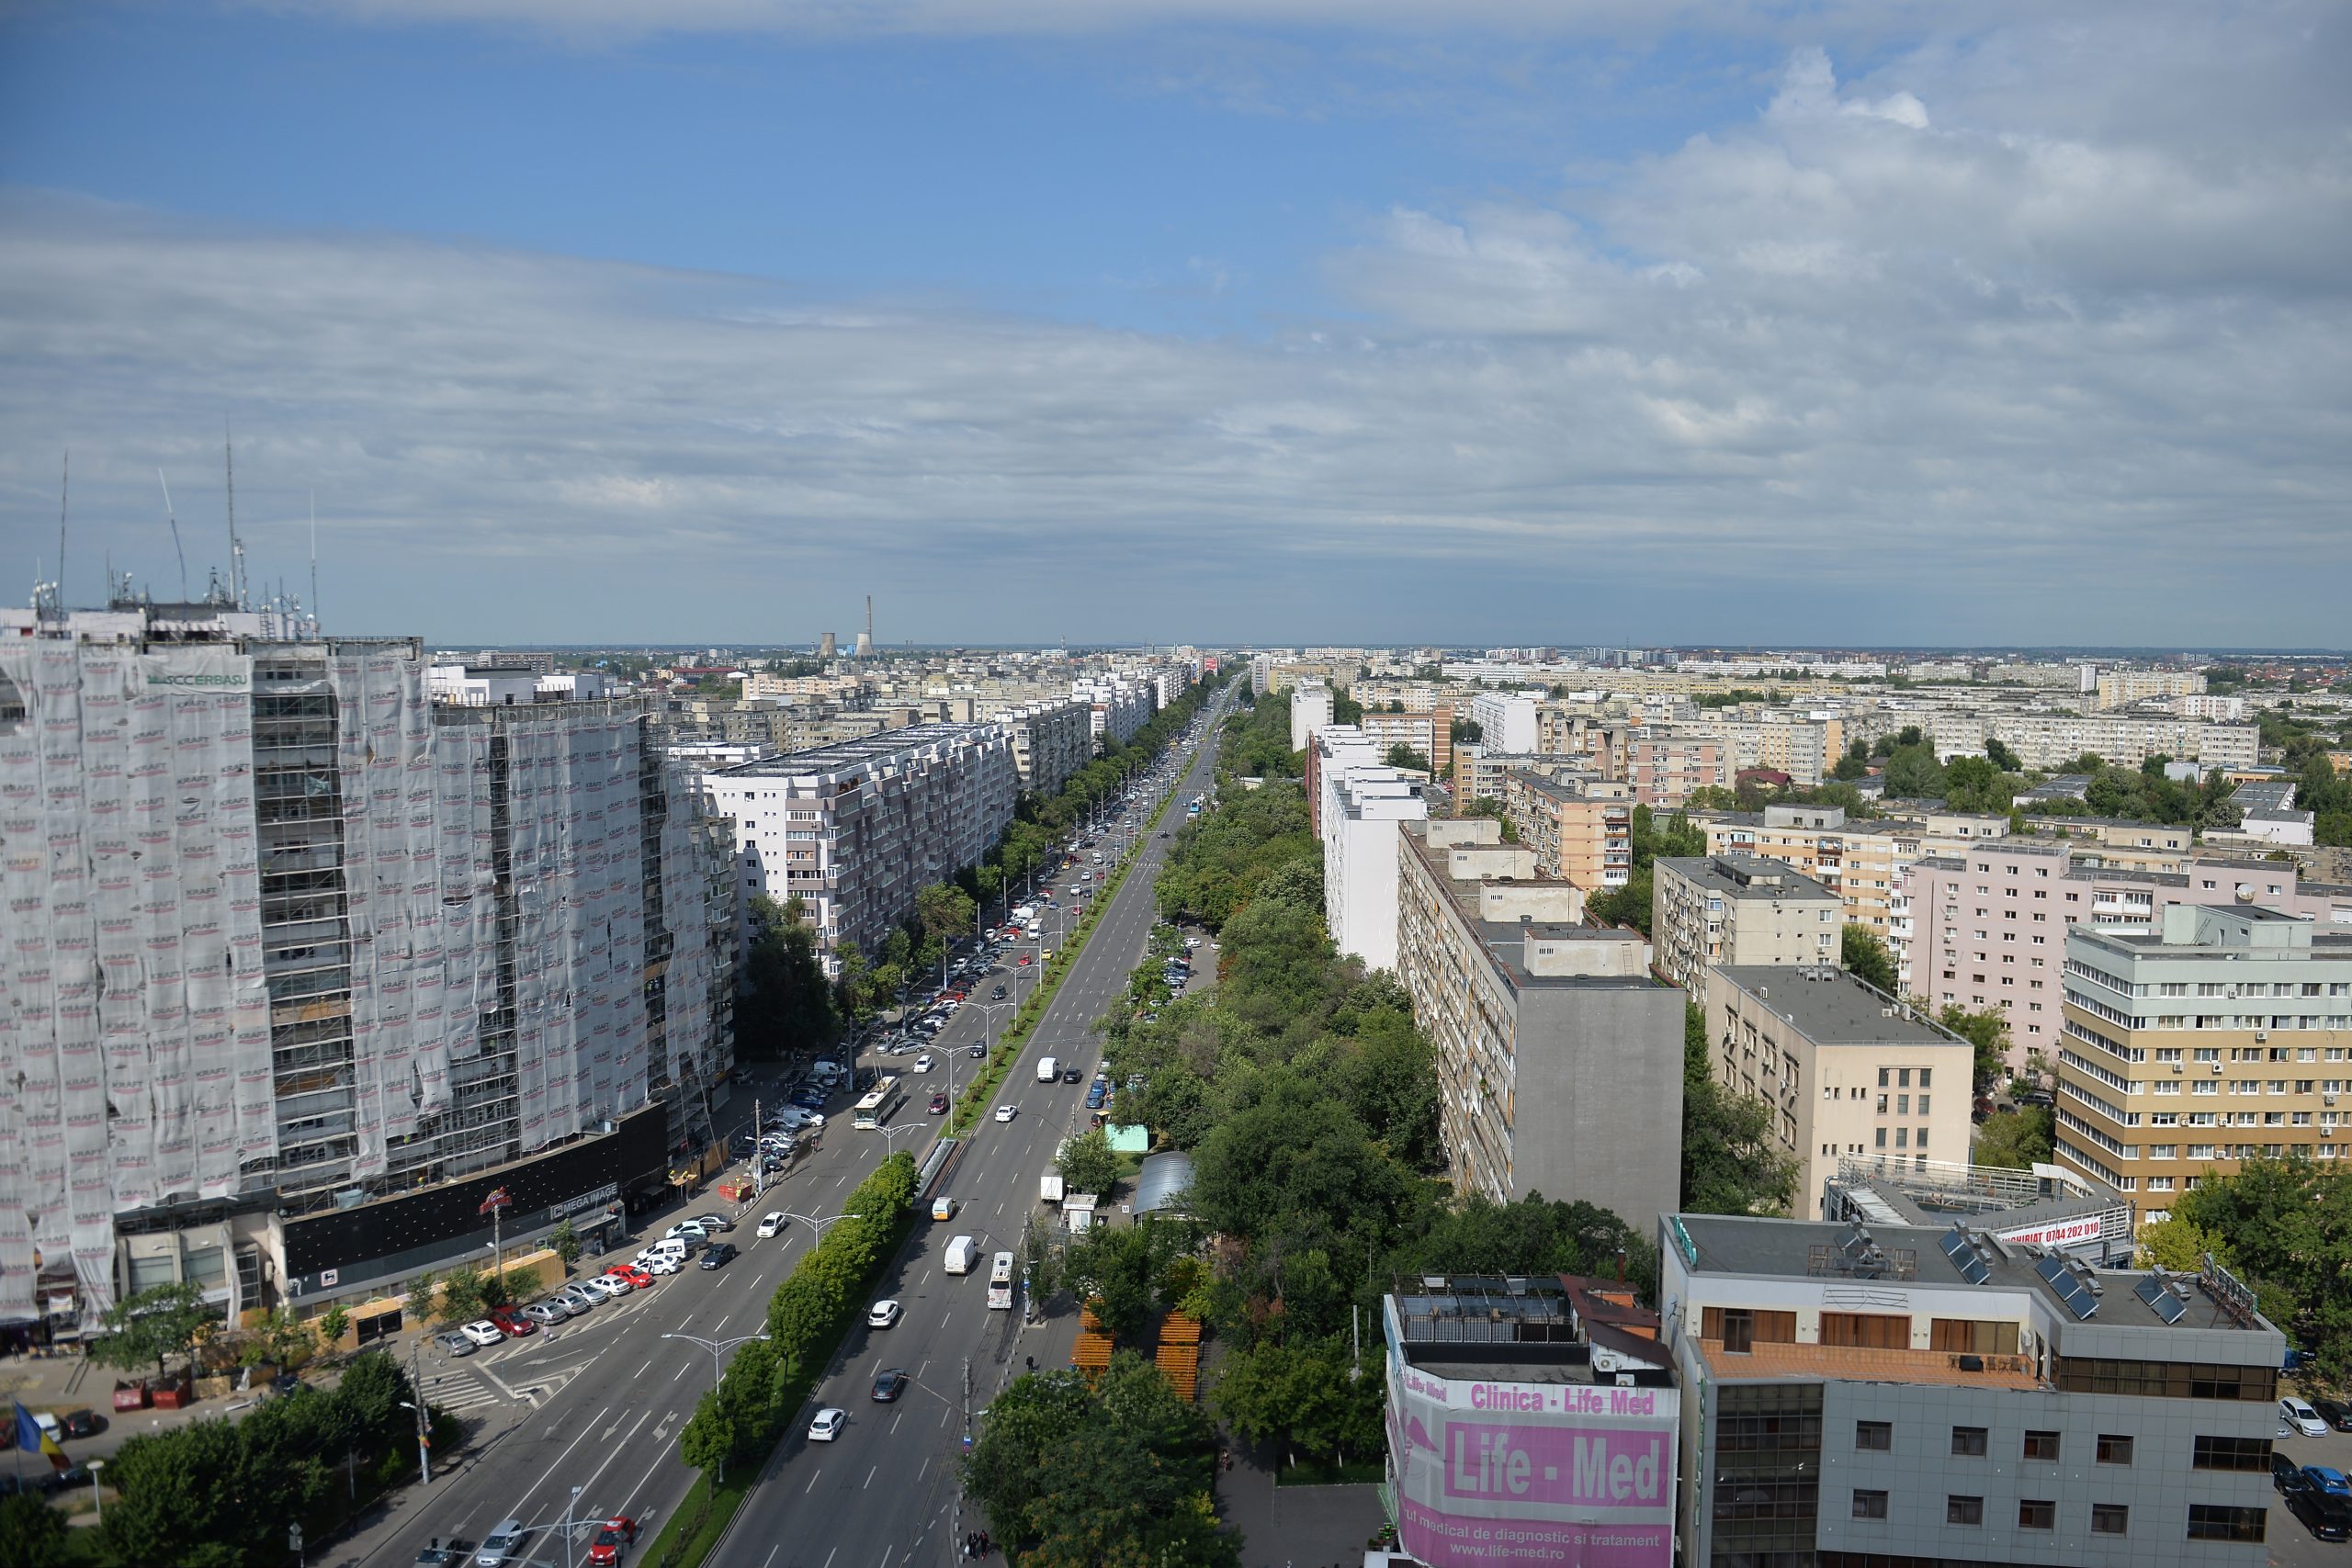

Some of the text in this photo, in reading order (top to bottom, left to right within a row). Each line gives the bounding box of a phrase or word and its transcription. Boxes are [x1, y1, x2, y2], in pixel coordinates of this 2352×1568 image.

[134, 694, 165, 706] KRAFT
[176, 700, 208, 708] KRAFT
[371, 723, 395, 732] KRAFT
[86, 729, 119, 738] KRAFT
[132, 728, 165, 740] KRAFT
[220, 728, 248, 738] KRAFT
[176, 736, 210, 746] KRAFT
[2, 750, 33, 759] KRAFT
[373, 756, 397, 764] KRAFT
[89, 764, 120, 773] KRAFT
[135, 762, 166, 773] KRAFT
[407, 789, 434, 798] KRAFT
[91, 798, 122, 809] KRAFT
[135, 796, 166, 807] KRAFT
[220, 796, 249, 806] KRAFT
[606, 799, 624, 809] KRAFT
[175, 812, 209, 822] KRAFT
[410, 814, 434, 823] KRAFT
[137, 830, 171, 839] KRAFT
[220, 826, 250, 834] KRAFT
[609, 826, 623, 837] KRAFT
[47, 831, 83, 842] KRAFT
[587, 837, 604, 846] KRAFT
[183, 845, 216, 853] KRAFT
[376, 849, 402, 857] KRAFT
[412, 847, 435, 857] KRAFT
[446, 852, 469, 861] KRAFT
[6, 858, 40, 866] KRAFT
[226, 863, 255, 871] KRAFT
[142, 864, 174, 873] KRAFT
[98, 876, 131, 885] KRAFT
[447, 881, 469, 890] KRAFT
[377, 882, 403, 891] KRAFT
[413, 881, 436, 891] KRAFT
[187, 887, 218, 896] KRAFT
[9, 897, 42, 906] KRAFT
[52, 902, 88, 910] KRAFT
[100, 918, 134, 927] KRAFT
[379, 916, 402, 924] KRAFT
[188, 921, 220, 931] KRAFT
[15, 937, 46, 945] KRAFT
[56, 937, 90, 945] KRAFT
[146, 935, 179, 943] KRAFT
[231, 932, 260, 942] KRAFT
[418, 943, 442, 955] KRAFT
[448, 944, 471, 954] KRAFT
[189, 964, 220, 975] KRAFT
[614, 960, 628, 970] KRAFT
[17, 969, 51, 977] KRAFT
[151, 971, 180, 979] KRAFT
[235, 966, 264, 976] KRAFT
[381, 979, 408, 989] KRAFT
[417, 974, 441, 984] KRAFT
[236, 997, 266, 1005] KRAFT
[592, 994, 608, 1002] KRAFT
[21, 1006, 51, 1015] KRAFT
[61, 1004, 92, 1013] KRAFT
[152, 1006, 181, 1015] KRAFT
[194, 1006, 225, 1015] KRAFT
[416, 1005, 443, 1017] KRAFT
[450, 1005, 474, 1016] KRAFT
[381, 1013, 408, 1022] KRAFT
[616, 1023, 630, 1034] KRAFT
[194, 1032, 225, 1042] KRAFT
[237, 1031, 266, 1040] KRAFT
[24, 1043, 53, 1051] KRAFT
[62, 1041, 96, 1049] KRAFT
[419, 1036, 443, 1048] KRAFT
[383, 1046, 410, 1056] KRAFT
[594, 1050, 611, 1060] KRAFT
[196, 1067, 227, 1077] KRAFT
[239, 1067, 268, 1077] KRAFT
[65, 1077, 98, 1087] KRAFT
[549, 1074, 569, 1085] KRAFT
[525, 1084, 543, 1097] KRAFT
[242, 1101, 269, 1111] KRAFT
[67, 1112, 100, 1122] KRAFT
[526, 1112, 544, 1126] KRAFT
[202, 1137, 233, 1149] KRAFT
[70, 1149, 104, 1157] KRAFT
[161, 1171, 192, 1182] KRAFT
[203, 1171, 234, 1182] KRAFT
[564, 1185, 617, 1213] MEGA IMAGE
[74, 1211, 107, 1221] KRAFT
[2046, 1229, 2065, 1242] 0744
[2067, 1225, 2083, 1238] 202
[2085, 1222, 2098, 1235] 010
[1471, 1384, 1544, 1411] Clinica
[1564, 1388, 1603, 1413] Life
[1611, 1390, 1655, 1415] Med
[1453, 1429, 1530, 1495] Life
[1573, 1436, 1658, 1499] Med
[1419, 1515, 1468, 1538] medical
[1473, 1527, 1490, 1540] de
[1495, 1529, 1569, 1543] diagnostic
[1574, 1533, 1587, 1544] si
[1590, 1535, 1660, 1547] tratament
[1451, 1543, 1565, 1560] www.life-med.ro
